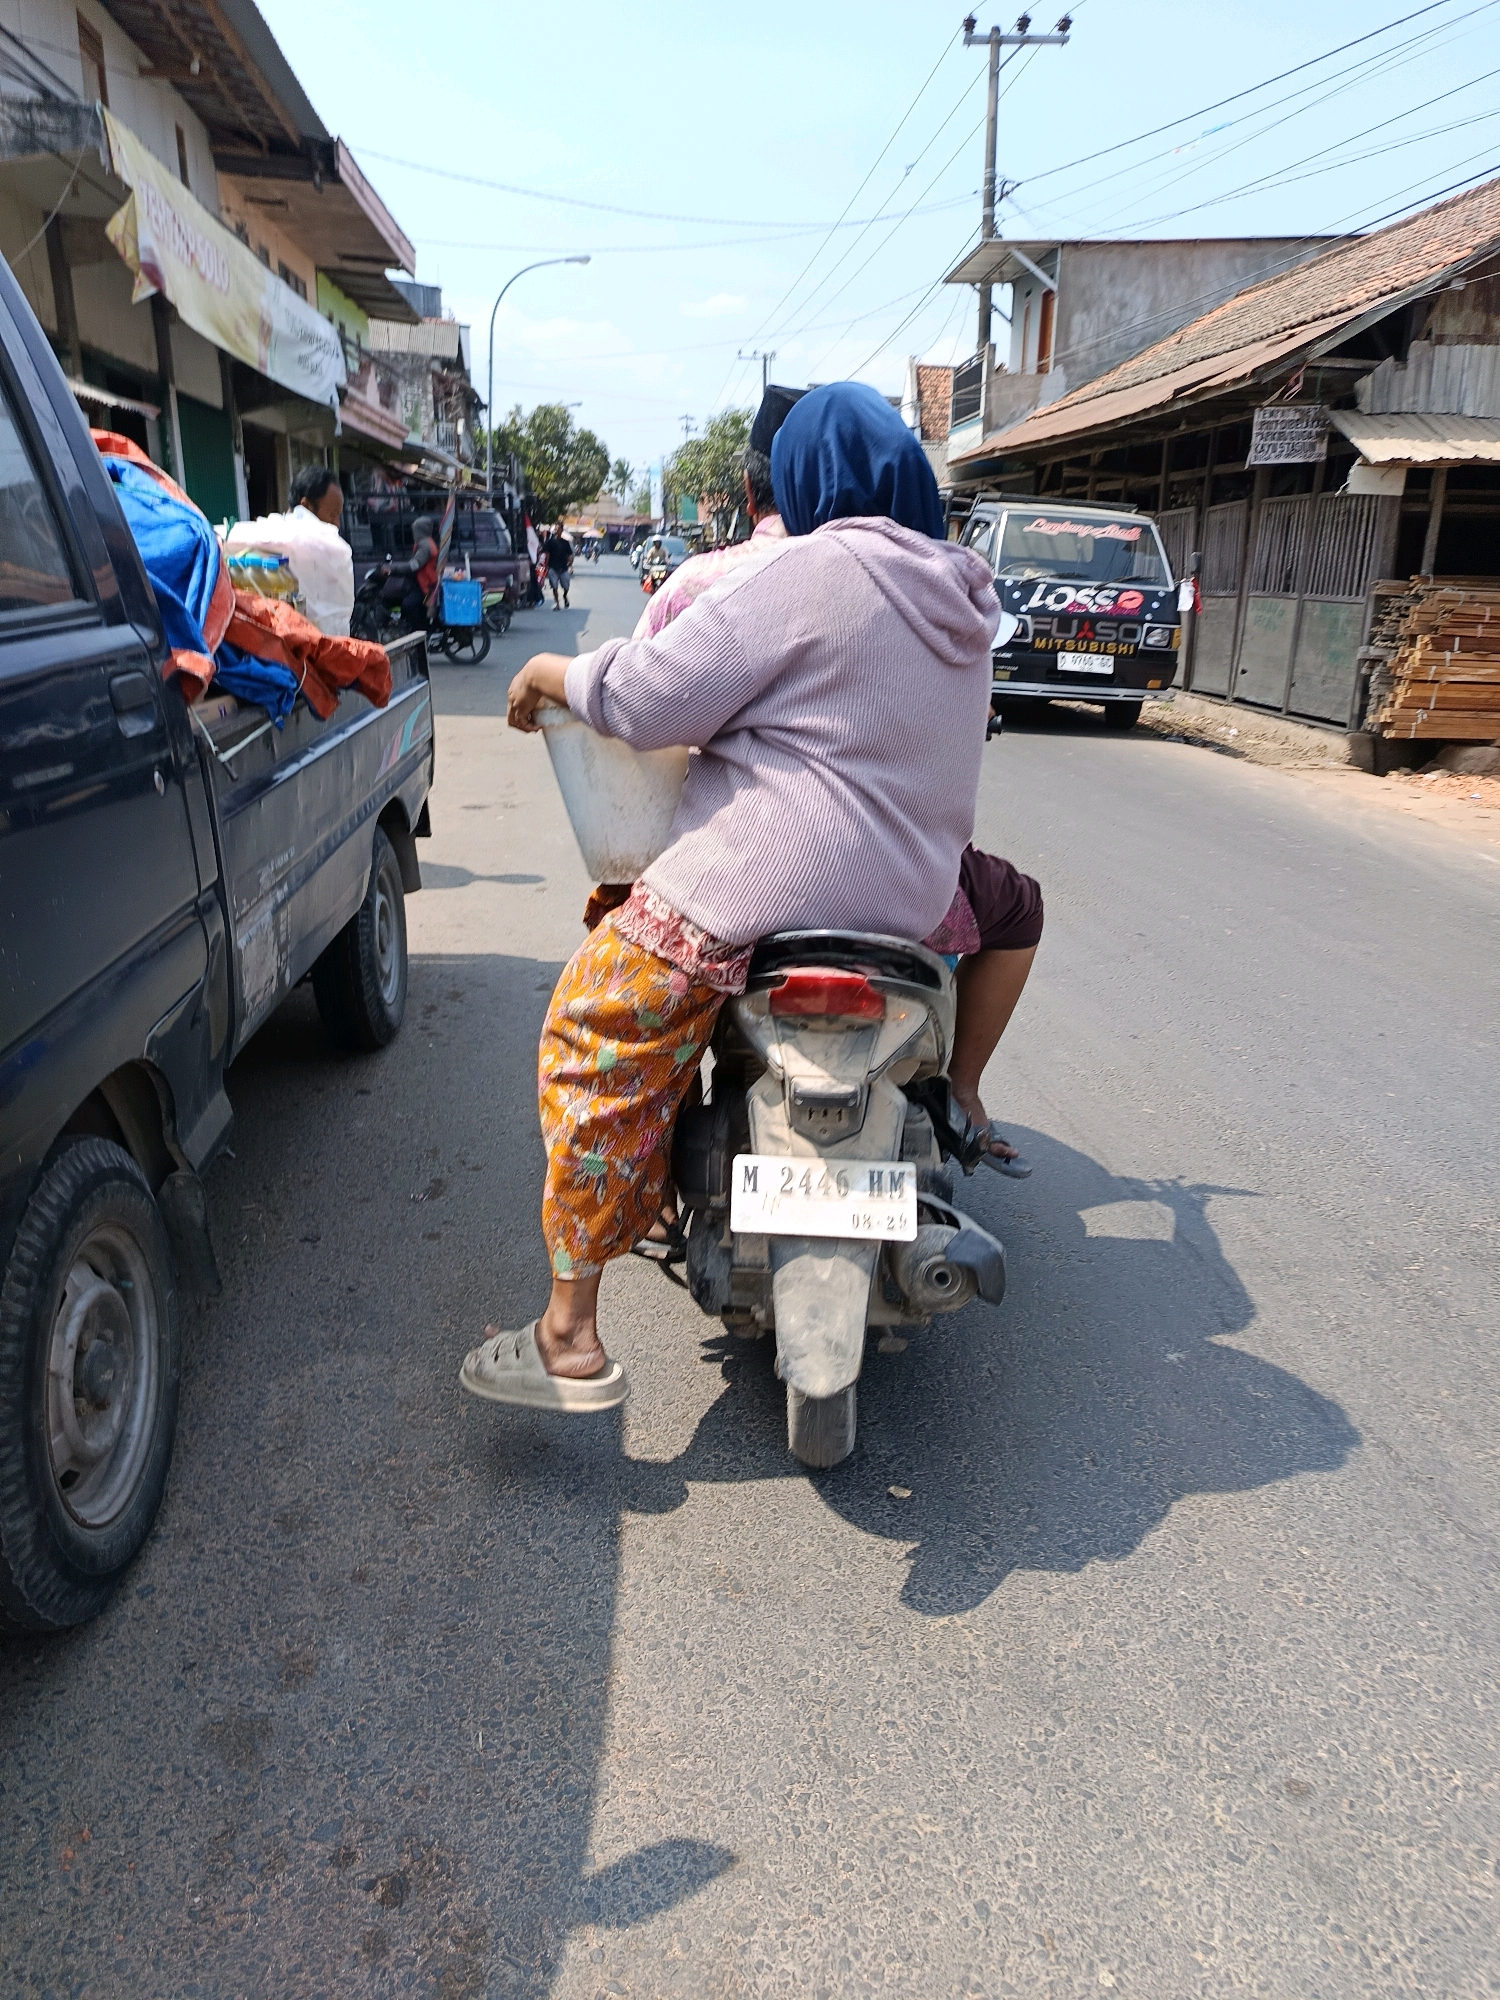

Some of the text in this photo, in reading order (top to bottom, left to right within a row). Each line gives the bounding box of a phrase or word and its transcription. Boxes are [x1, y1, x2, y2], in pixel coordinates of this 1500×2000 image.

[1034, 637, 1135, 655] MITSUBISHI
[742, 1165, 907, 1200] M 2446 HM
